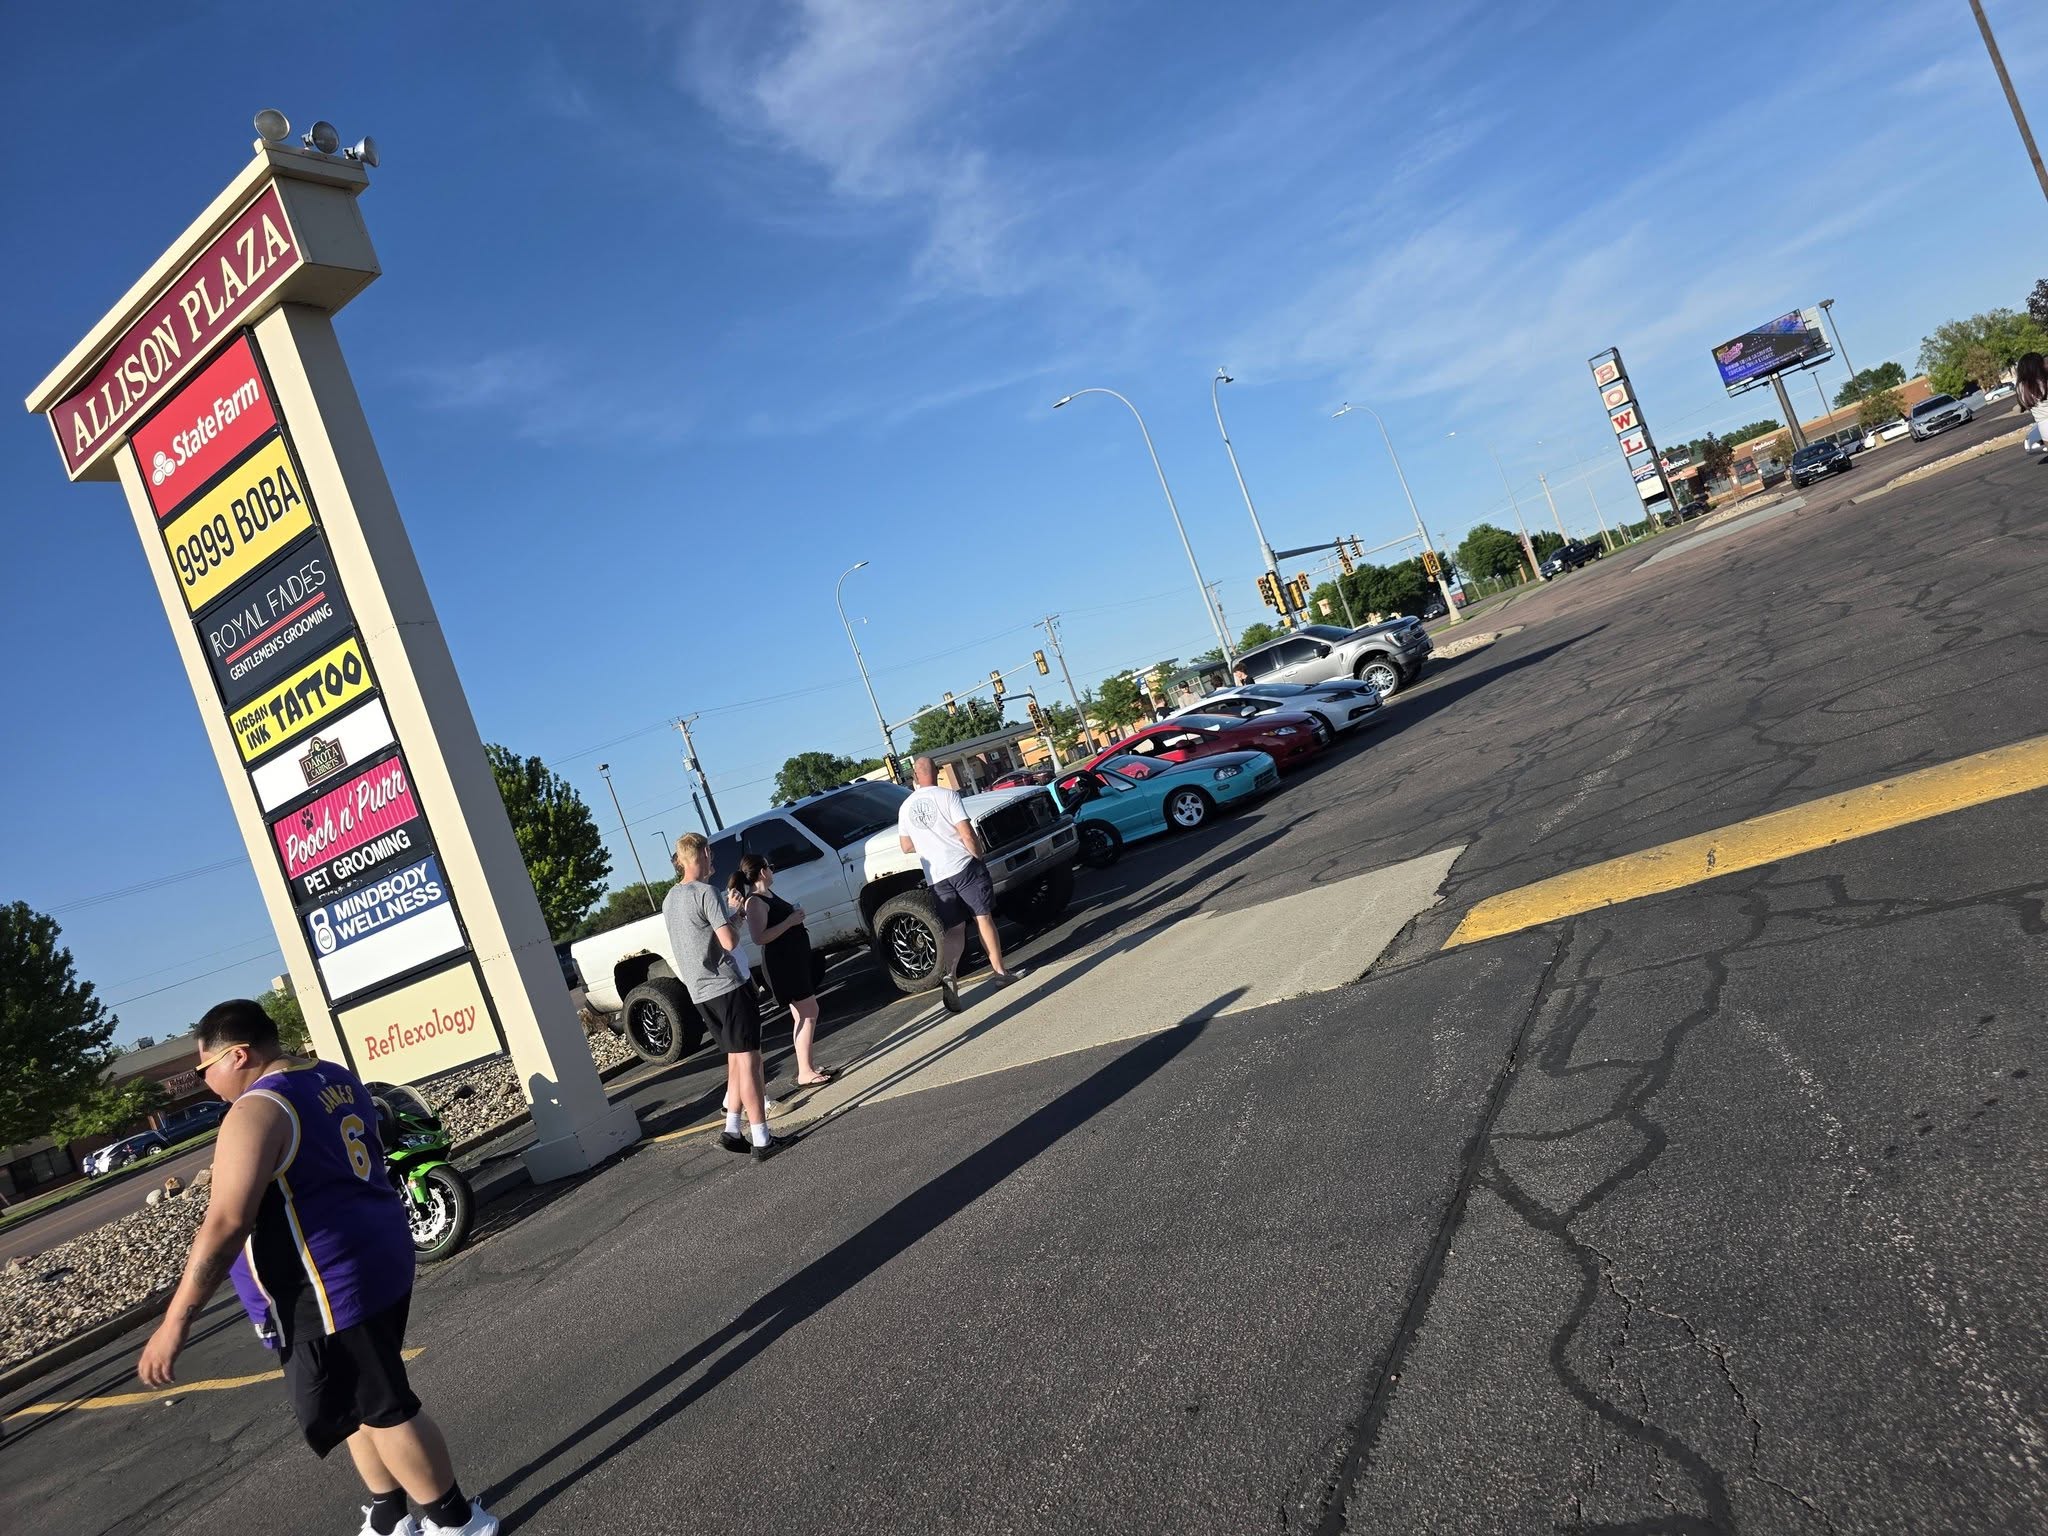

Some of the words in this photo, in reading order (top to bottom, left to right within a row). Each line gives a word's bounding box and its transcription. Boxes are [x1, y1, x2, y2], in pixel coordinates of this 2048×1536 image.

[71, 315, 182, 457] ALLISON
[179, 213, 291, 343] PLAZA
[1597, 365, 1643, 454] BOWL
[176, 514, 234, 587] 9999
[231, 464, 301, 544] BOBA
[210, 602, 269, 658] ROYAL
[267, 559, 326, 619] FADES
[230, 637, 285, 681] GENTLEMEN'S
[283, 602, 333, 645] GROOMING
[236, 703, 268, 735] URBAN
[270, 650, 362, 732] TATTOO
[246, 723, 271, 751] INK
[304, 746, 339, 771] DAKOTA
[310, 758, 339, 777] CABINETS
[286, 809, 338, 873] Pooch
[357, 770, 406, 815] Purr
[304, 866, 332, 895] PET
[332, 829, 411, 881] GROOMING
[334, 862, 428, 921] MINDBODY
[335, 881, 442, 941] WELLNESS
[364, 1004, 476, 1061] Reflexology
[317, 1084, 355, 1114] JAMES
[339, 1114, 371, 1182] 6
